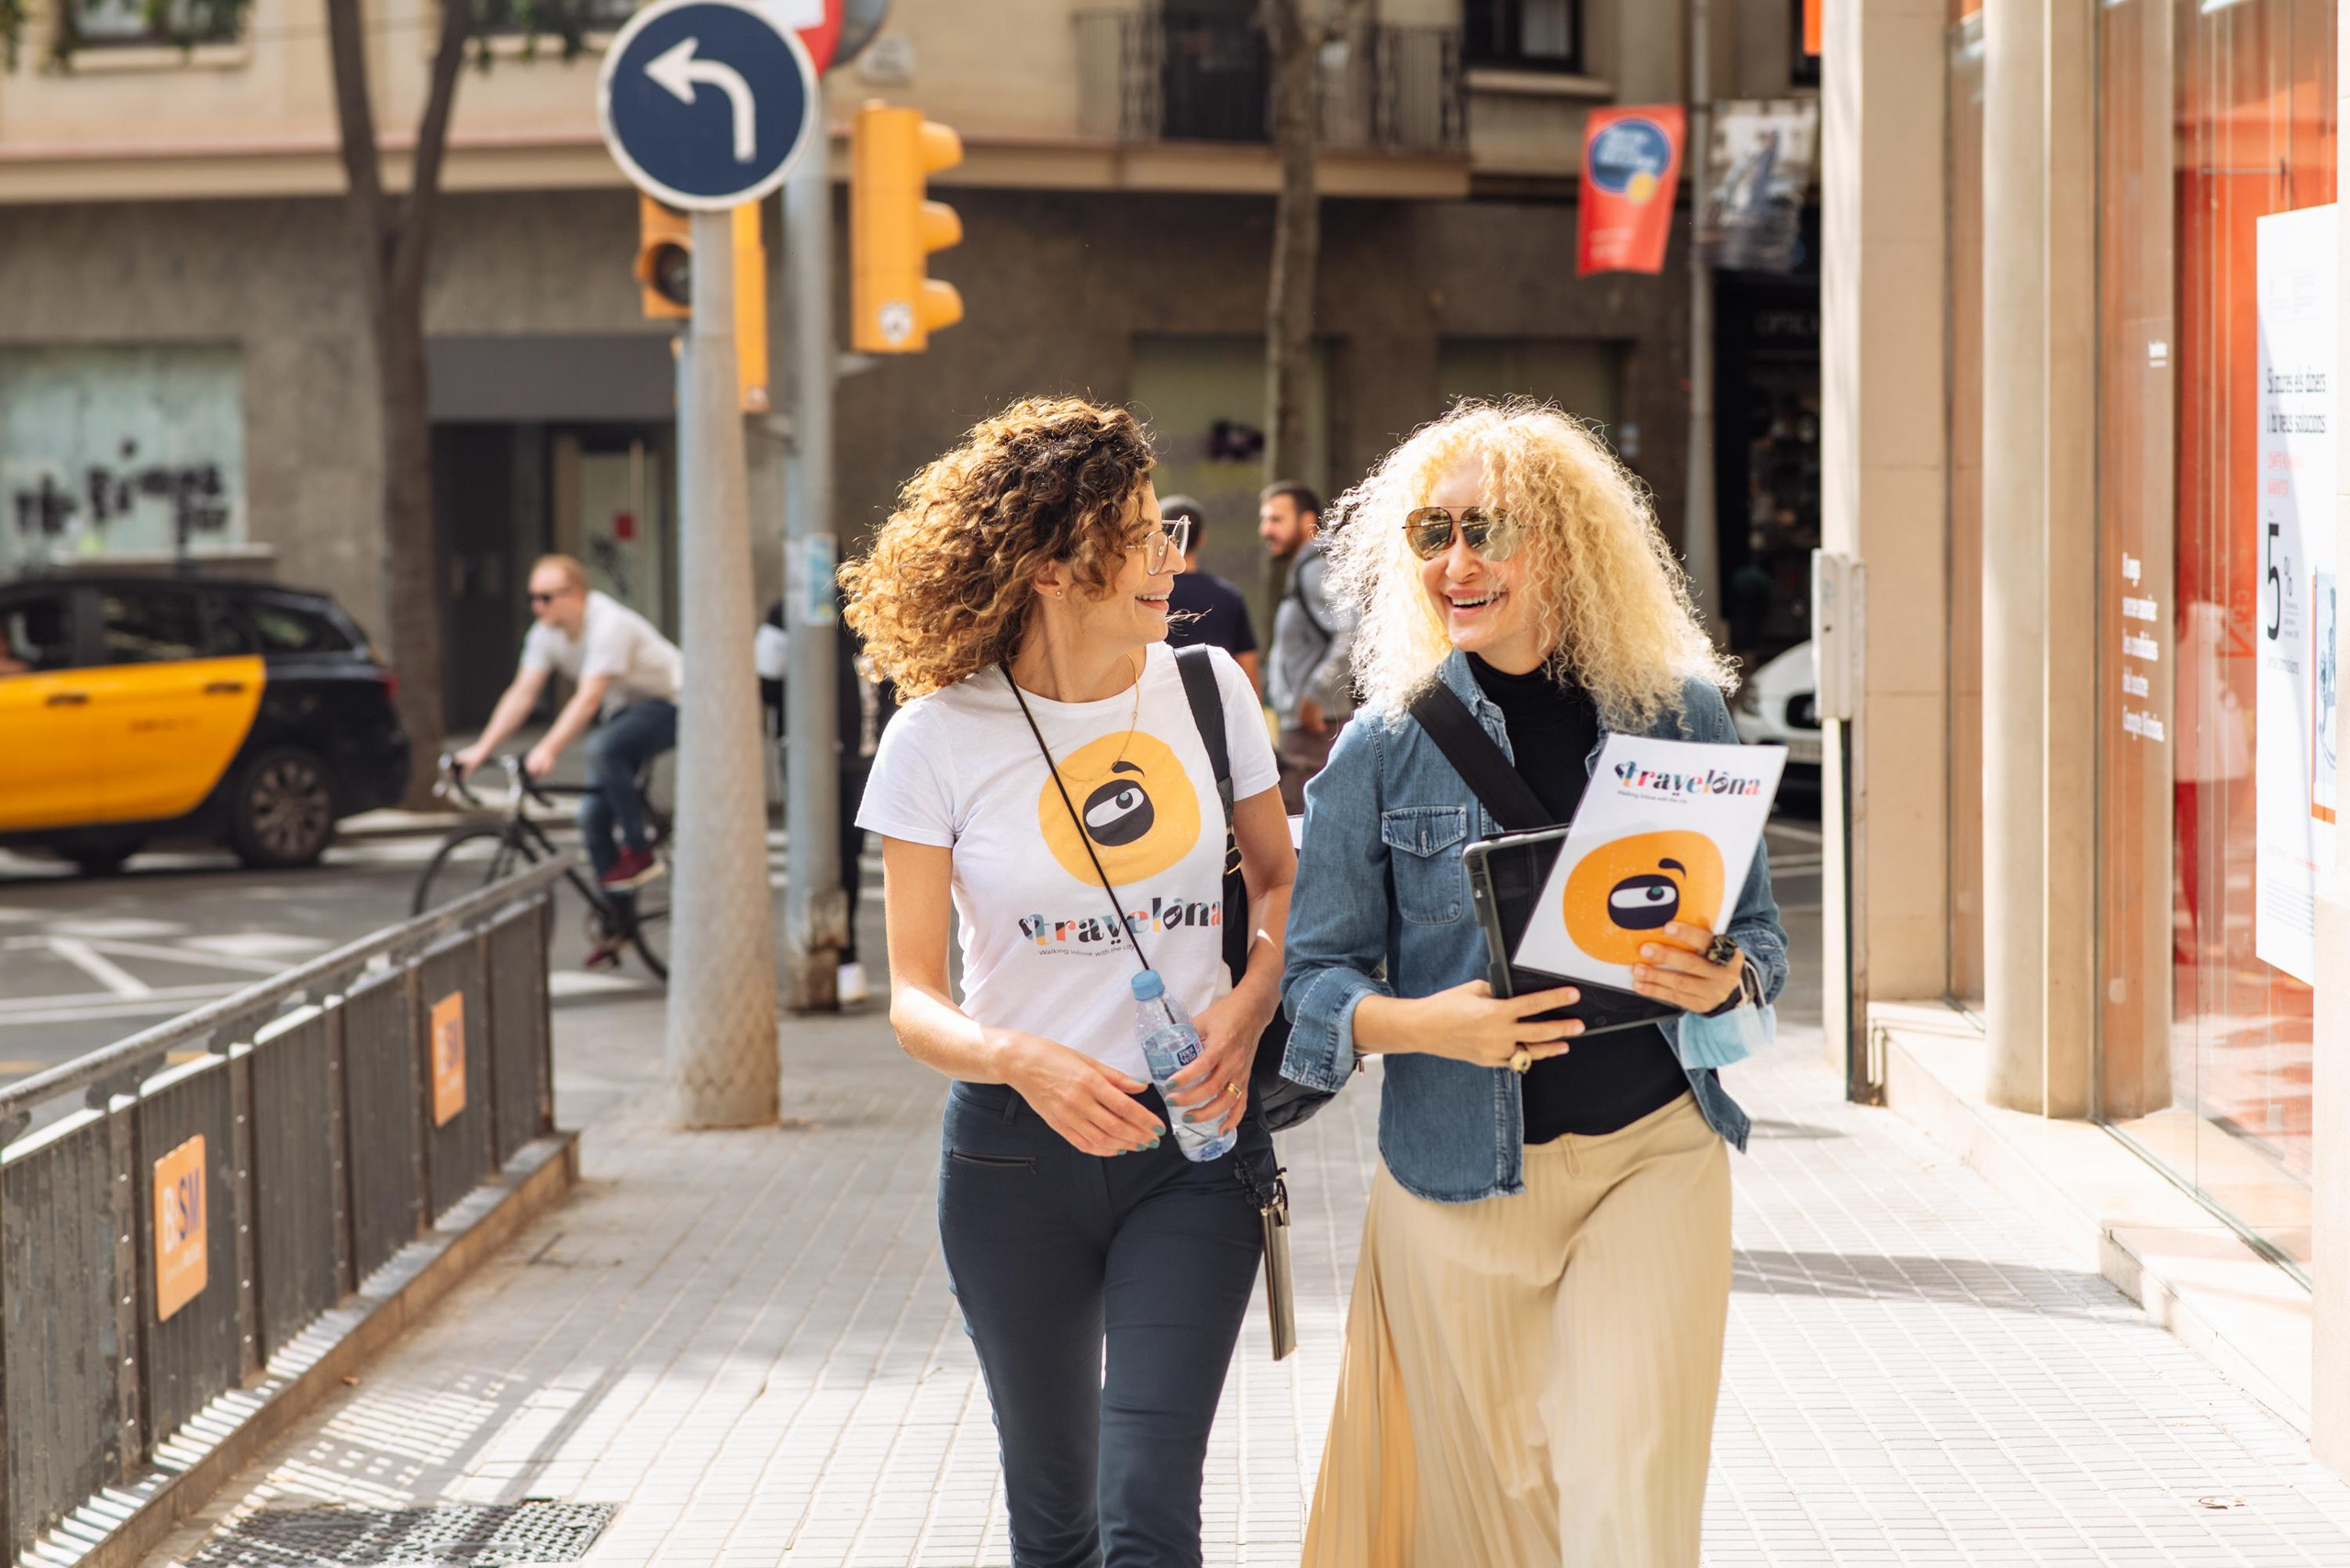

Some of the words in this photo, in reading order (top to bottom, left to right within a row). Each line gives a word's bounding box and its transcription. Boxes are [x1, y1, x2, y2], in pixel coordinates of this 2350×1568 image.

[1038, 947, 1069, 956] Walking
[1095, 948, 1110, 958] with
[1111, 945, 1122, 953] the
